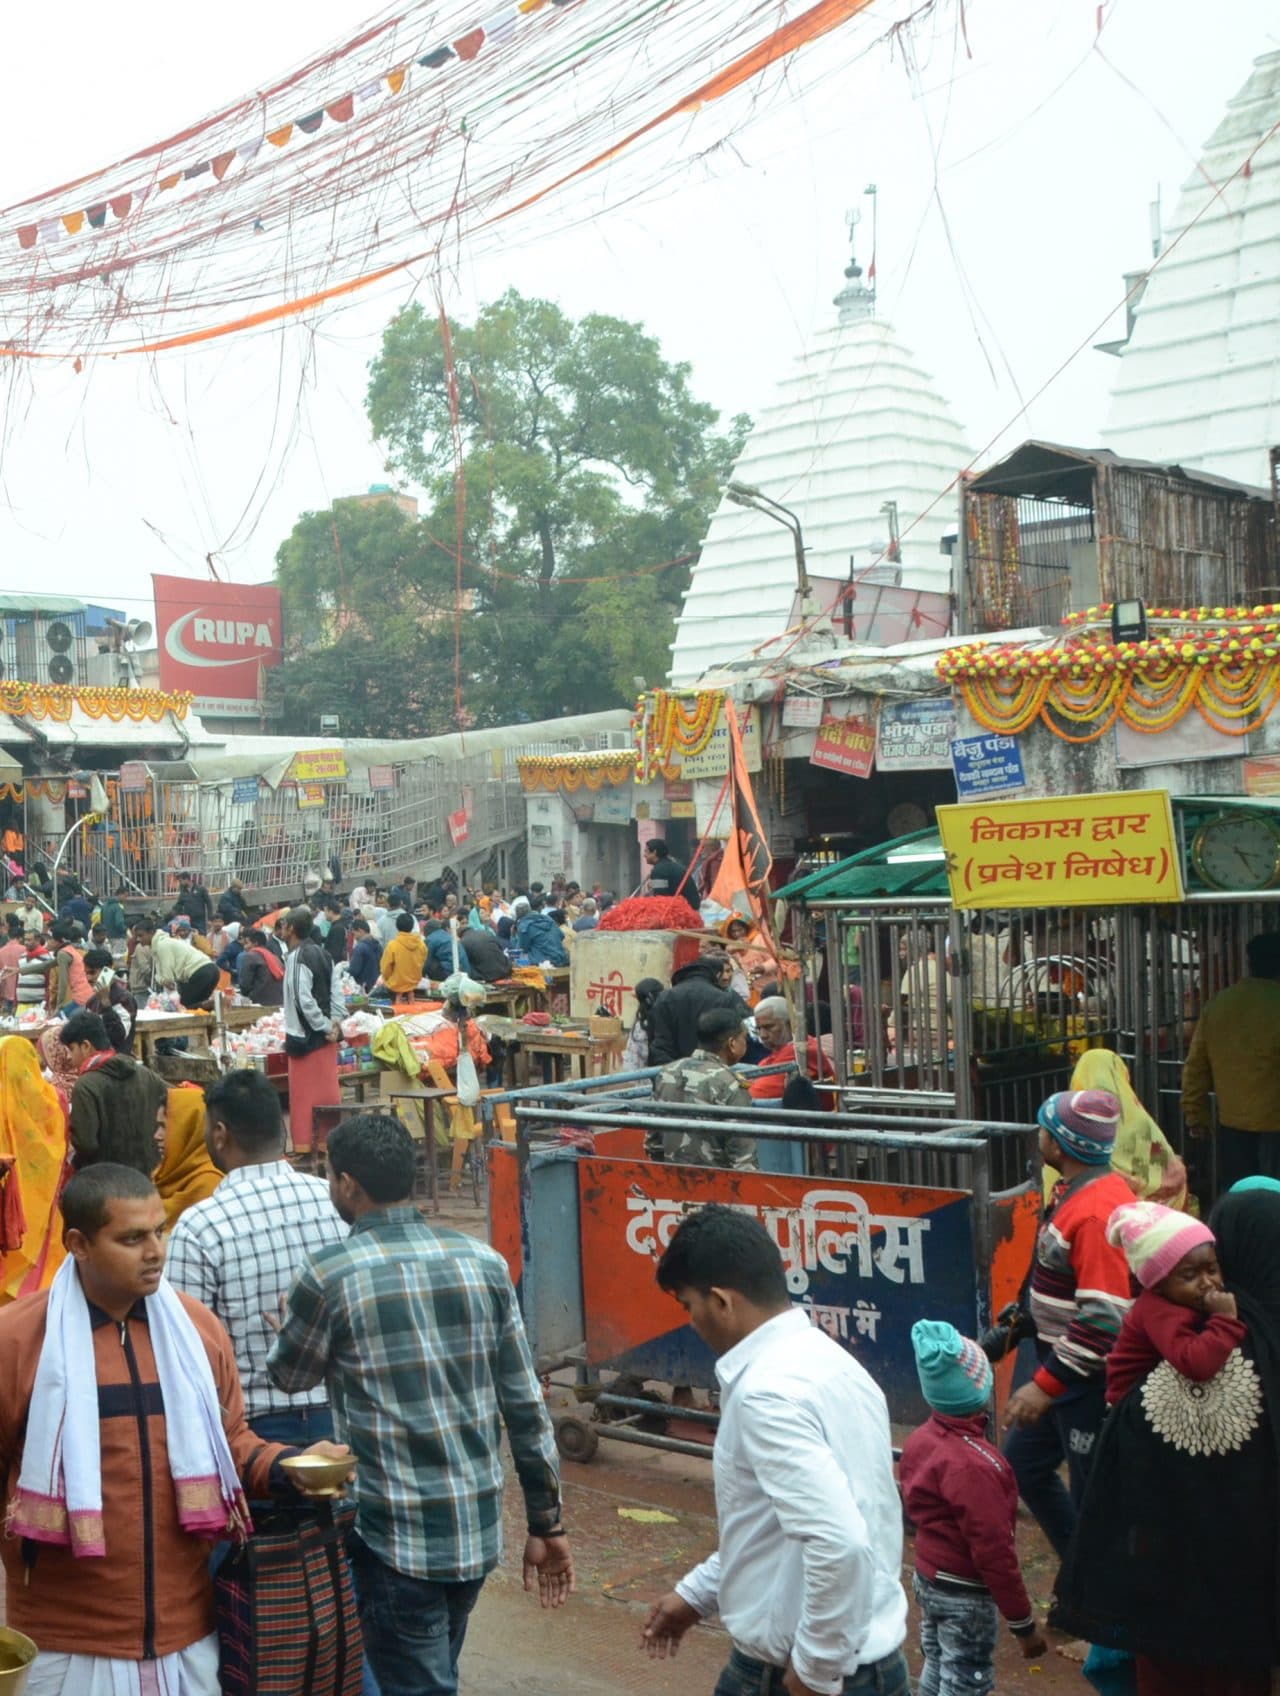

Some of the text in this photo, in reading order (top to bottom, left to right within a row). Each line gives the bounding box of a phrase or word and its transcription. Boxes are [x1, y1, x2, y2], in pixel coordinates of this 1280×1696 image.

[194, 617, 273, 648] RUPA
[970, 813, 1151, 844] निकास द्वार
[963, 847, 1170, 892] (प्रवेश निषेध)
[852, 1299, 882, 1343] में
